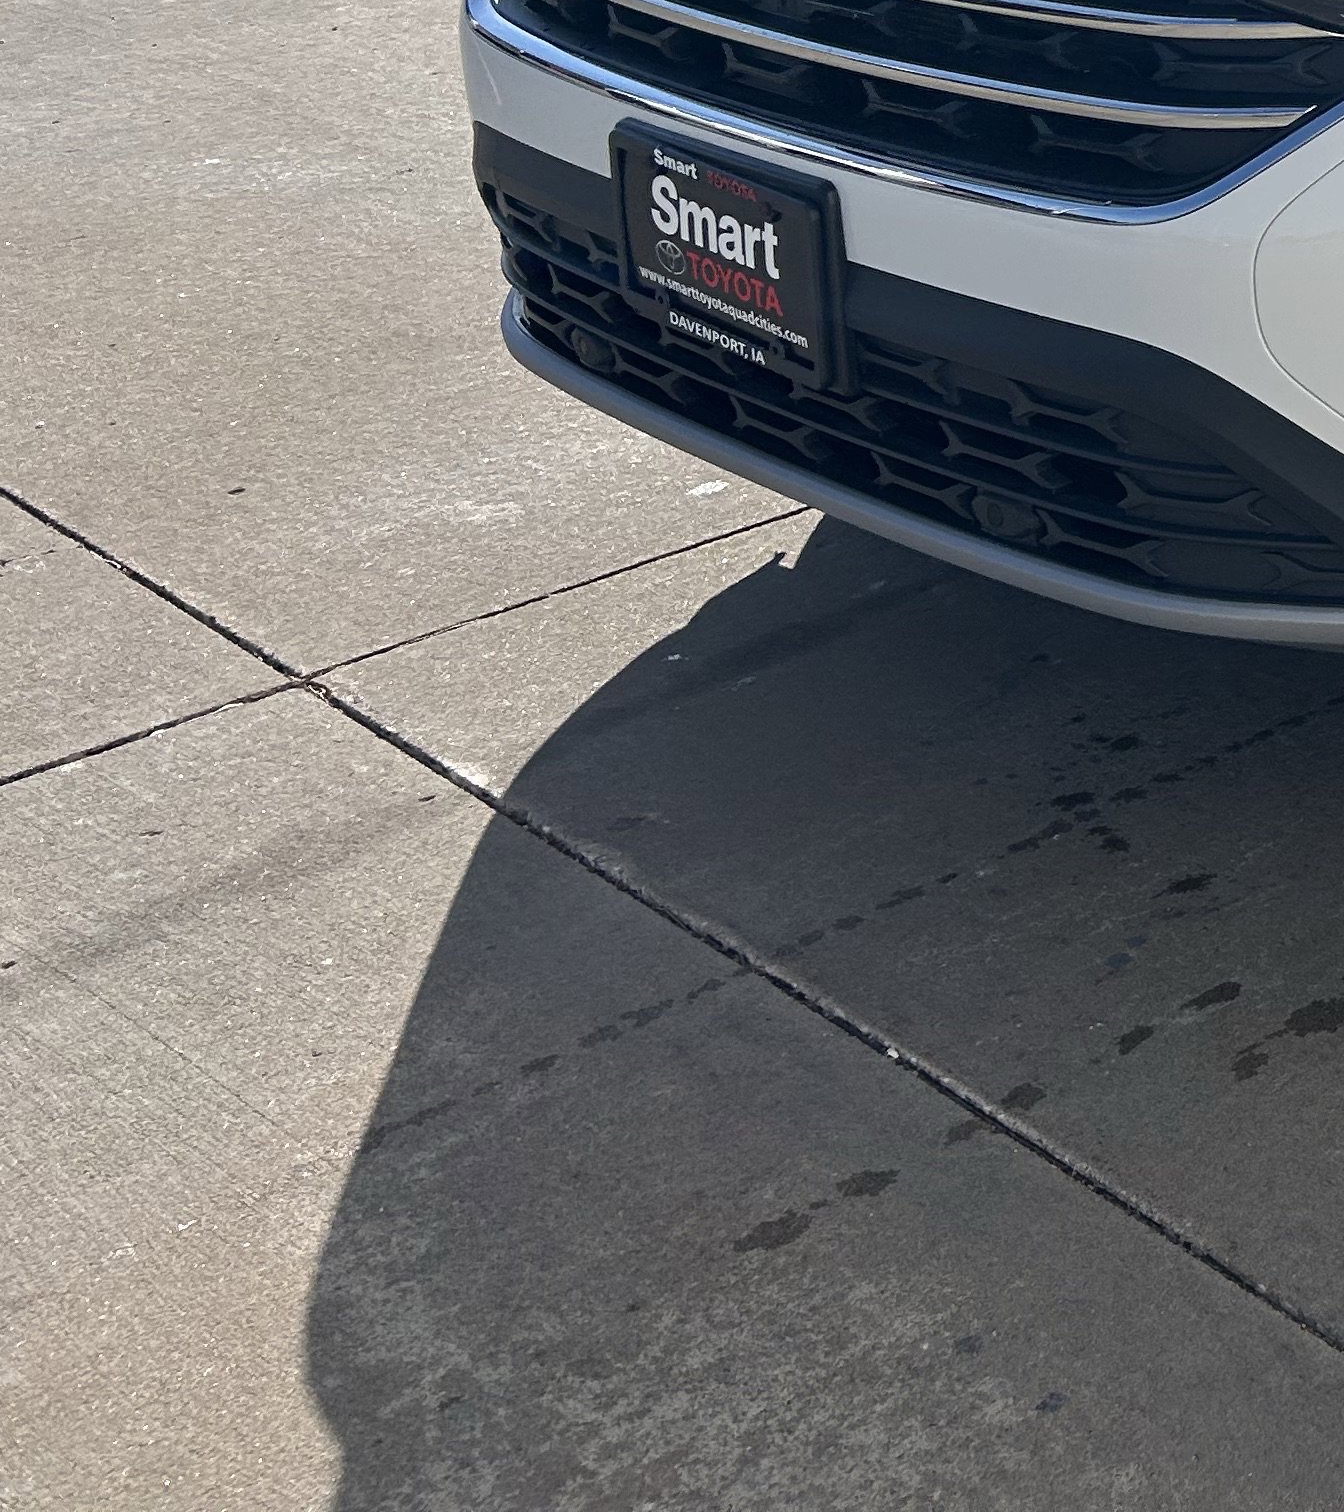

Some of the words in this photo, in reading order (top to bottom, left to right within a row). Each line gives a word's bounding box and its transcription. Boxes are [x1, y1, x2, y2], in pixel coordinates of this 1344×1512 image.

[653, 147, 698, 180] Smart
[705, 169, 757, 202] TOYOTA
[650, 174, 780, 280] Smart
[638, 265, 809, 349] www.smarttoyotaquadcities.com
[685, 250, 784, 317] TOYOTA
[668, 310, 749, 360] DAVENPORT,
[751, 347, 766, 366] IA
